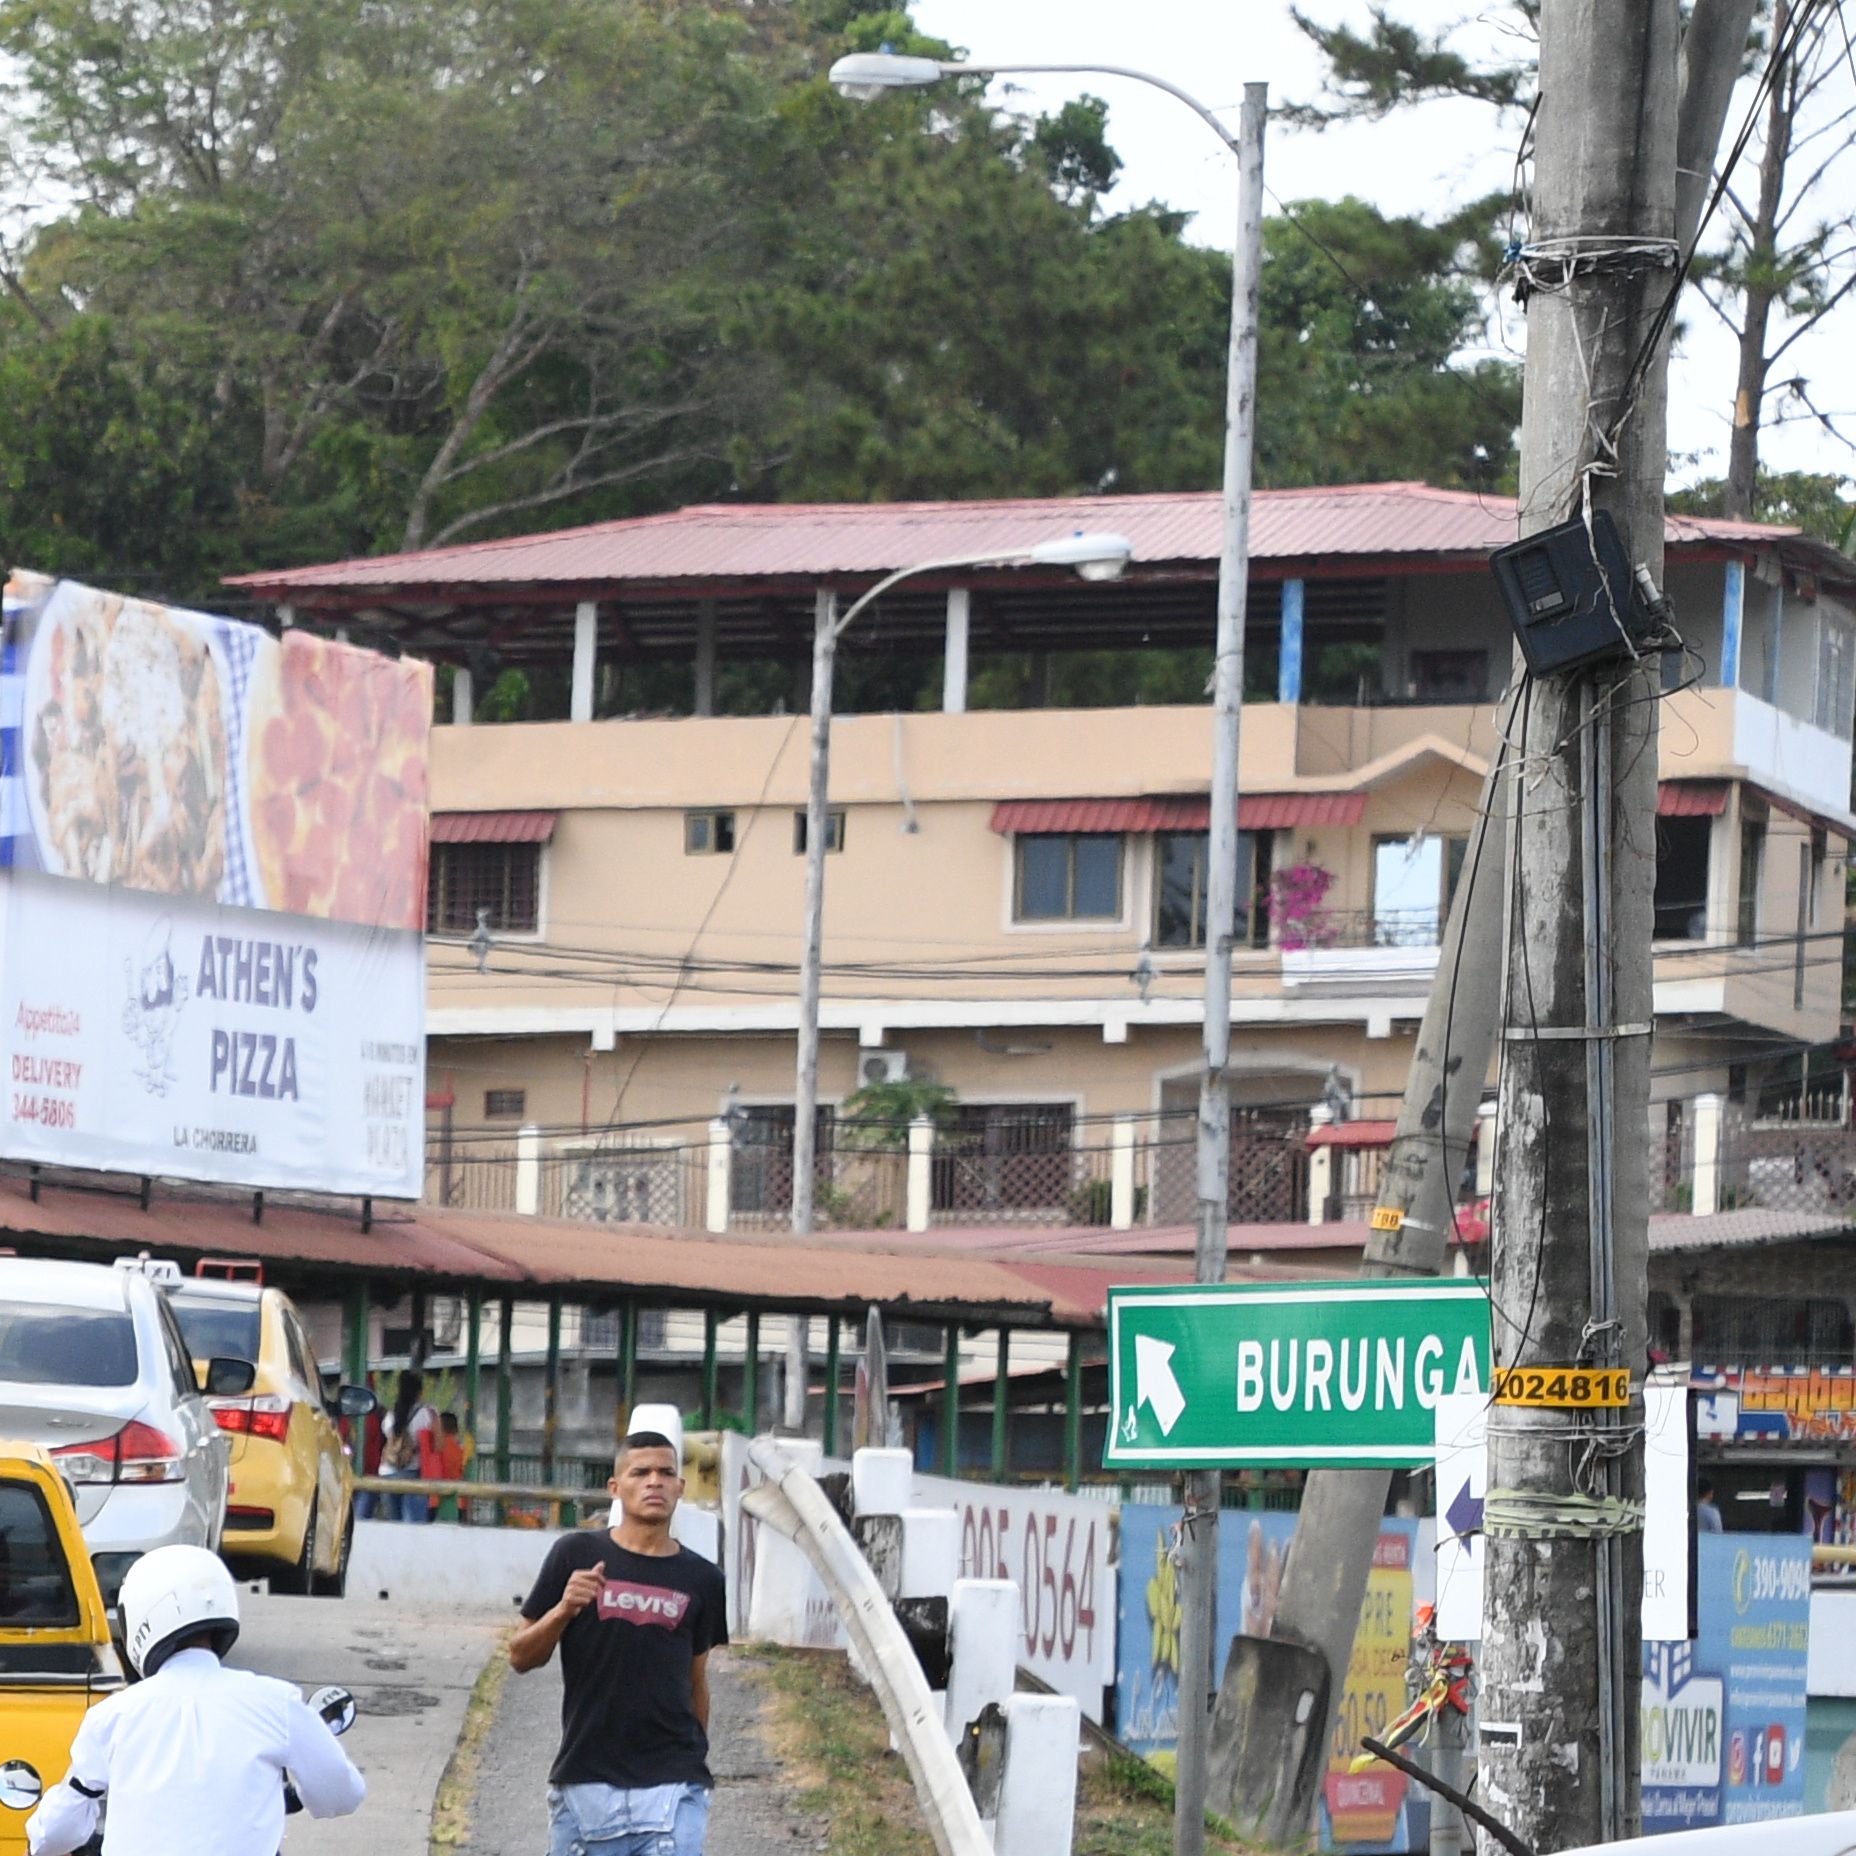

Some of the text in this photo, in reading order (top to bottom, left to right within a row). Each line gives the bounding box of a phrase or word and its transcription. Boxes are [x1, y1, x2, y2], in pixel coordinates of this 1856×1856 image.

[196, 935, 319, 1013] ATHEN'S
[12, 1055, 82, 1090] DELIVERY
[209, 1029, 299, 1102] PIZZA
[173, 1125, 257, 1154] LA CHORRERA
[1236, 1335, 1481, 1412] BURUNGA
[1024, 1510, 1096, 1664] 0564
